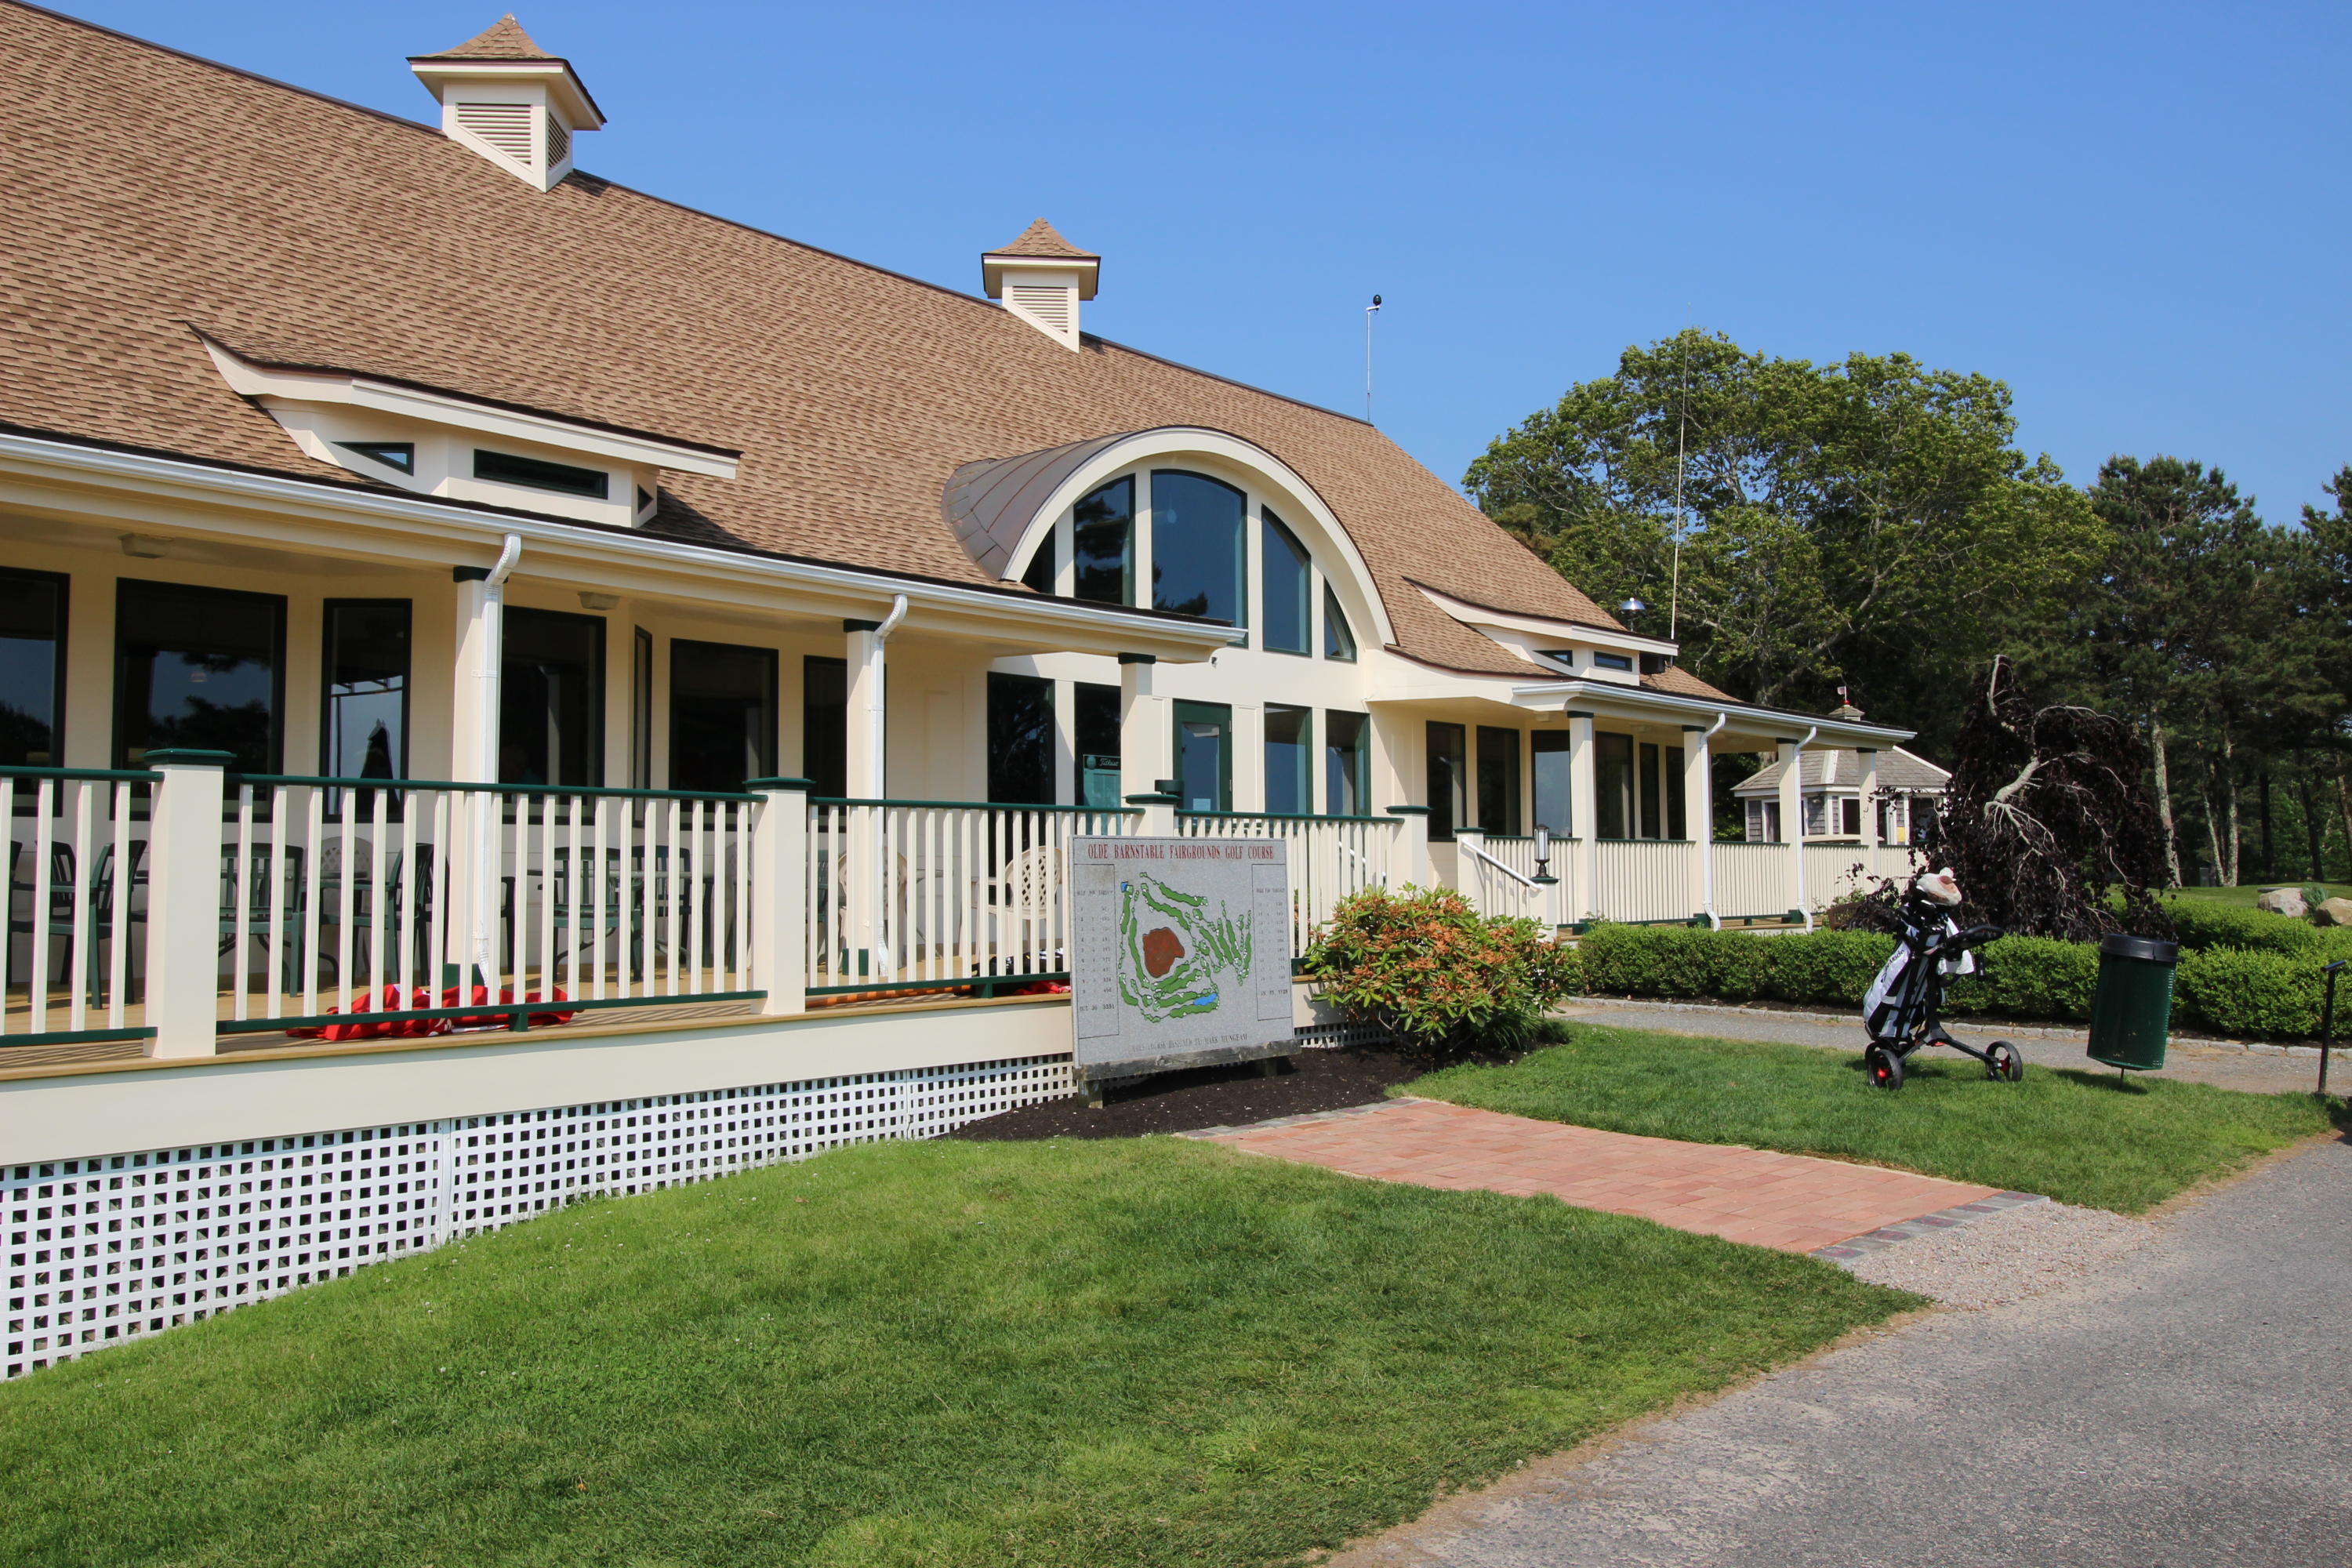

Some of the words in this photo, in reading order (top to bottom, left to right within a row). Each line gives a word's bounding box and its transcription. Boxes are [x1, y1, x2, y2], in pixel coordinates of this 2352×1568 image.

[1087, 844, 1109, 859] OLDE
[1114, 844, 1165, 859] BARNSTABLE
[1170, 844, 1221, 859] FAIRGROUNDS
[1225, 845, 1243, 859] GOLF
[1248, 845, 1274, 859] COURSE
